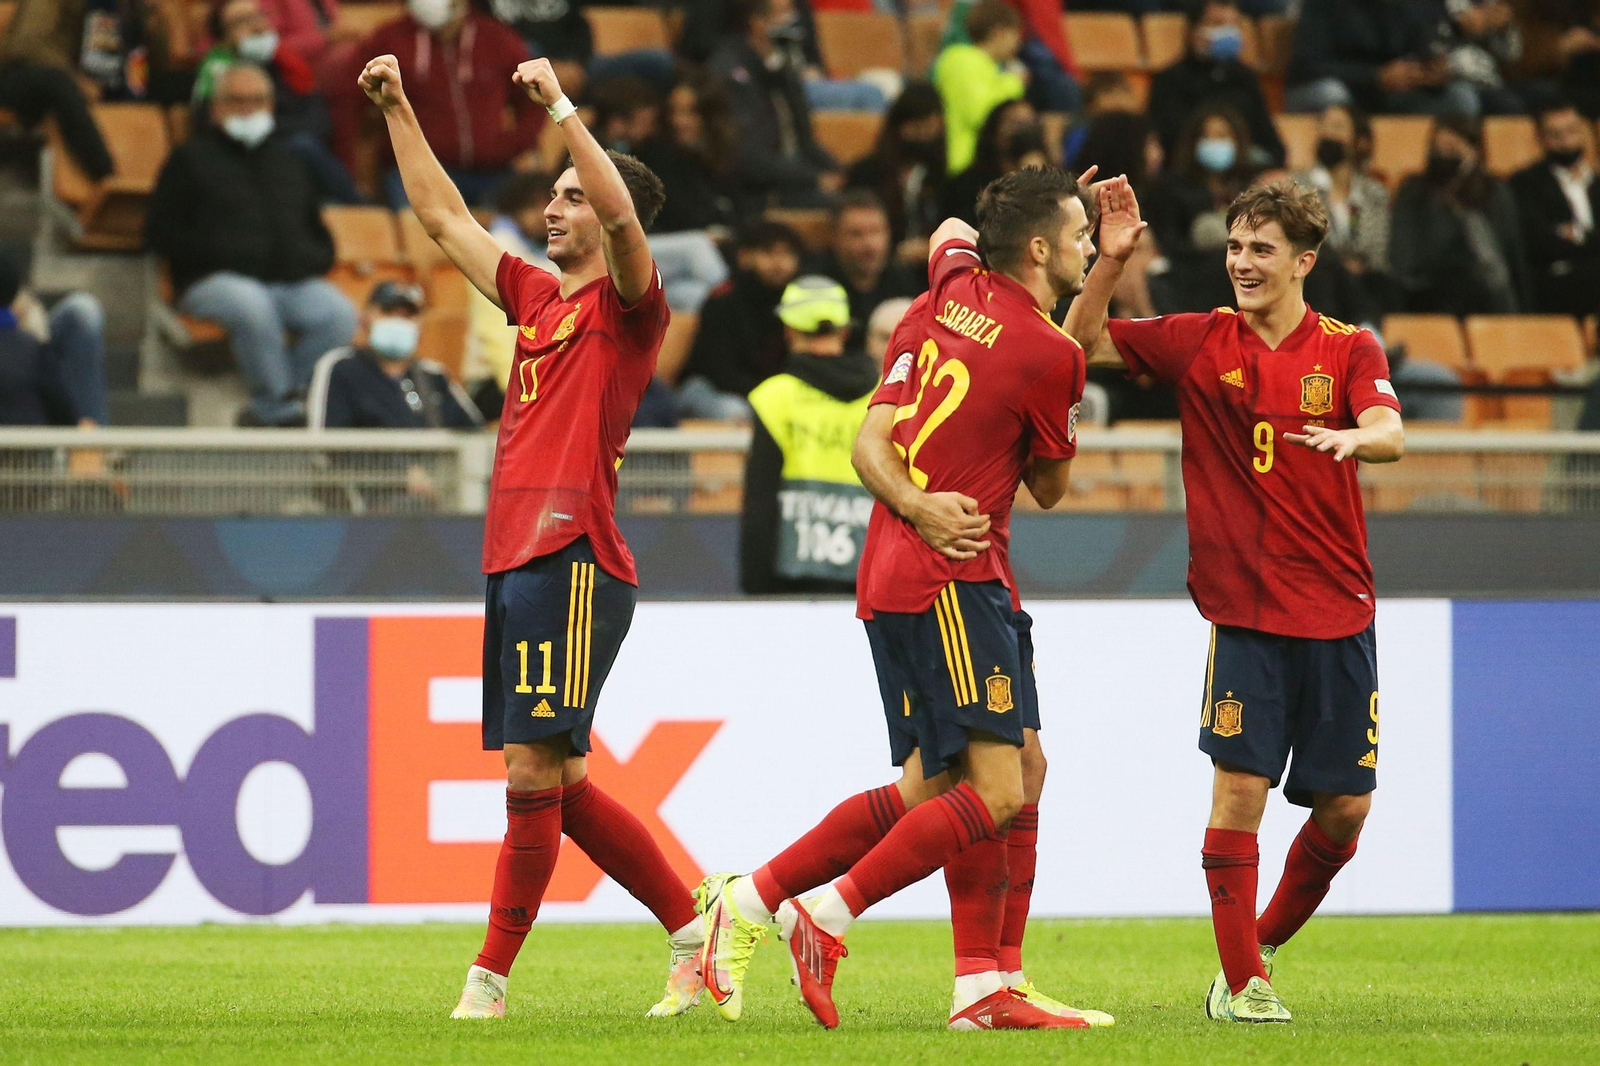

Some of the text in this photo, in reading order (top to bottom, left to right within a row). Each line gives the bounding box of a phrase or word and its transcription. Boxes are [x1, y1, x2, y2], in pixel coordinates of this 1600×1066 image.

[935, 300, 1004, 349] SARABIA
[519, 355, 546, 402] 11
[1219, 375, 1245, 389] adidas
[893, 338, 970, 490] 22
[1253, 421, 1275, 474] 9
[515, 640, 557, 693] 11
[530, 710, 556, 718] adidas
[1366, 690, 1379, 745] 9
